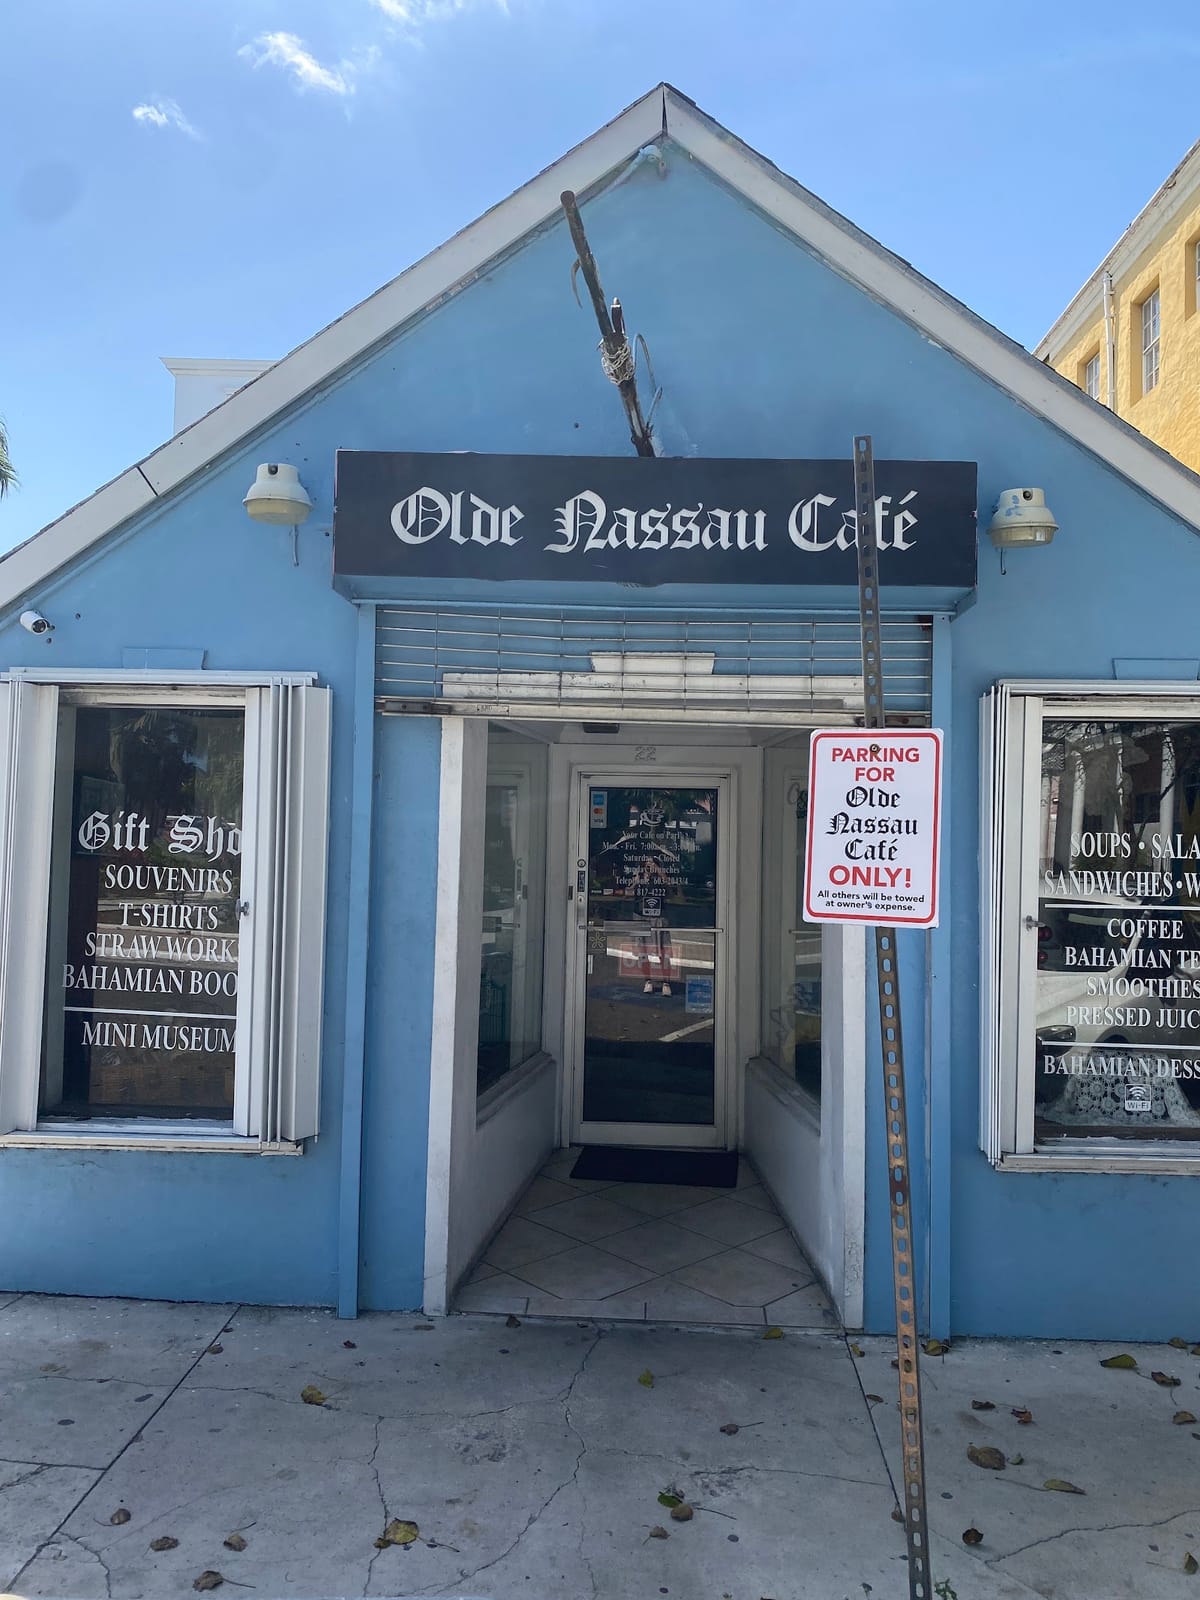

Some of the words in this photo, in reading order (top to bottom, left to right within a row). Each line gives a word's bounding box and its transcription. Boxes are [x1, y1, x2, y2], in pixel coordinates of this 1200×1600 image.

[390, 486, 525, 547] Olde
[543, 489, 769, 553] Nassau
[788, 490, 918, 552] Café
[634, 746, 656, 761] 22
[832, 747, 920, 762] PARKING
[855, 767, 895, 782] FOR
[846, 786, 901, 808] Olde
[825, 812, 919, 835] Nassau
[78, 810, 150, 853] Gift
[168, 814, 242, 862] Sho
[1071, 832, 1131, 858] SOUPS
[1152, 833, 1200, 859] SALA
[844, 838, 899, 861] Café
[105, 864, 233, 894] SOUVENIRS
[829, 865, 912, 889] ONLY!
[1044, 870, 1173, 898] SANDWICHES
[817, 890, 830, 899] All
[832, 891, 860, 900] others
[862, 892, 878, 901] will
[880, 893, 892, 901] be
[895, 894, 925, 903] towed
[825, 900, 835, 908] at
[837, 900, 873, 909] owner's
[874, 902, 916, 912] expense.
[118, 902, 219, 930] T-SHIRTS
[1107, 918, 1184, 939] COFFEE
[84, 932, 163, 960] STRAW
[166, 935, 239, 963] WORK
[1064, 946, 1172, 969] BAHAMIAN
[62, 964, 184, 994] BAHAMIAN
[189, 970, 238, 997] BOO
[1087, 977, 1200, 999] SMOOTHIES
[1066, 1006, 1150, 1027] PRESSED
[1156, 1008, 1200, 1029] JUIC
[81, 1021, 136, 1048] MINI
[141, 1025, 236, 1053] MUSEUM
[1043, 1055, 1150, 1078] BAHAMIAN
[1157, 1059, 1200, 1079] DESS
